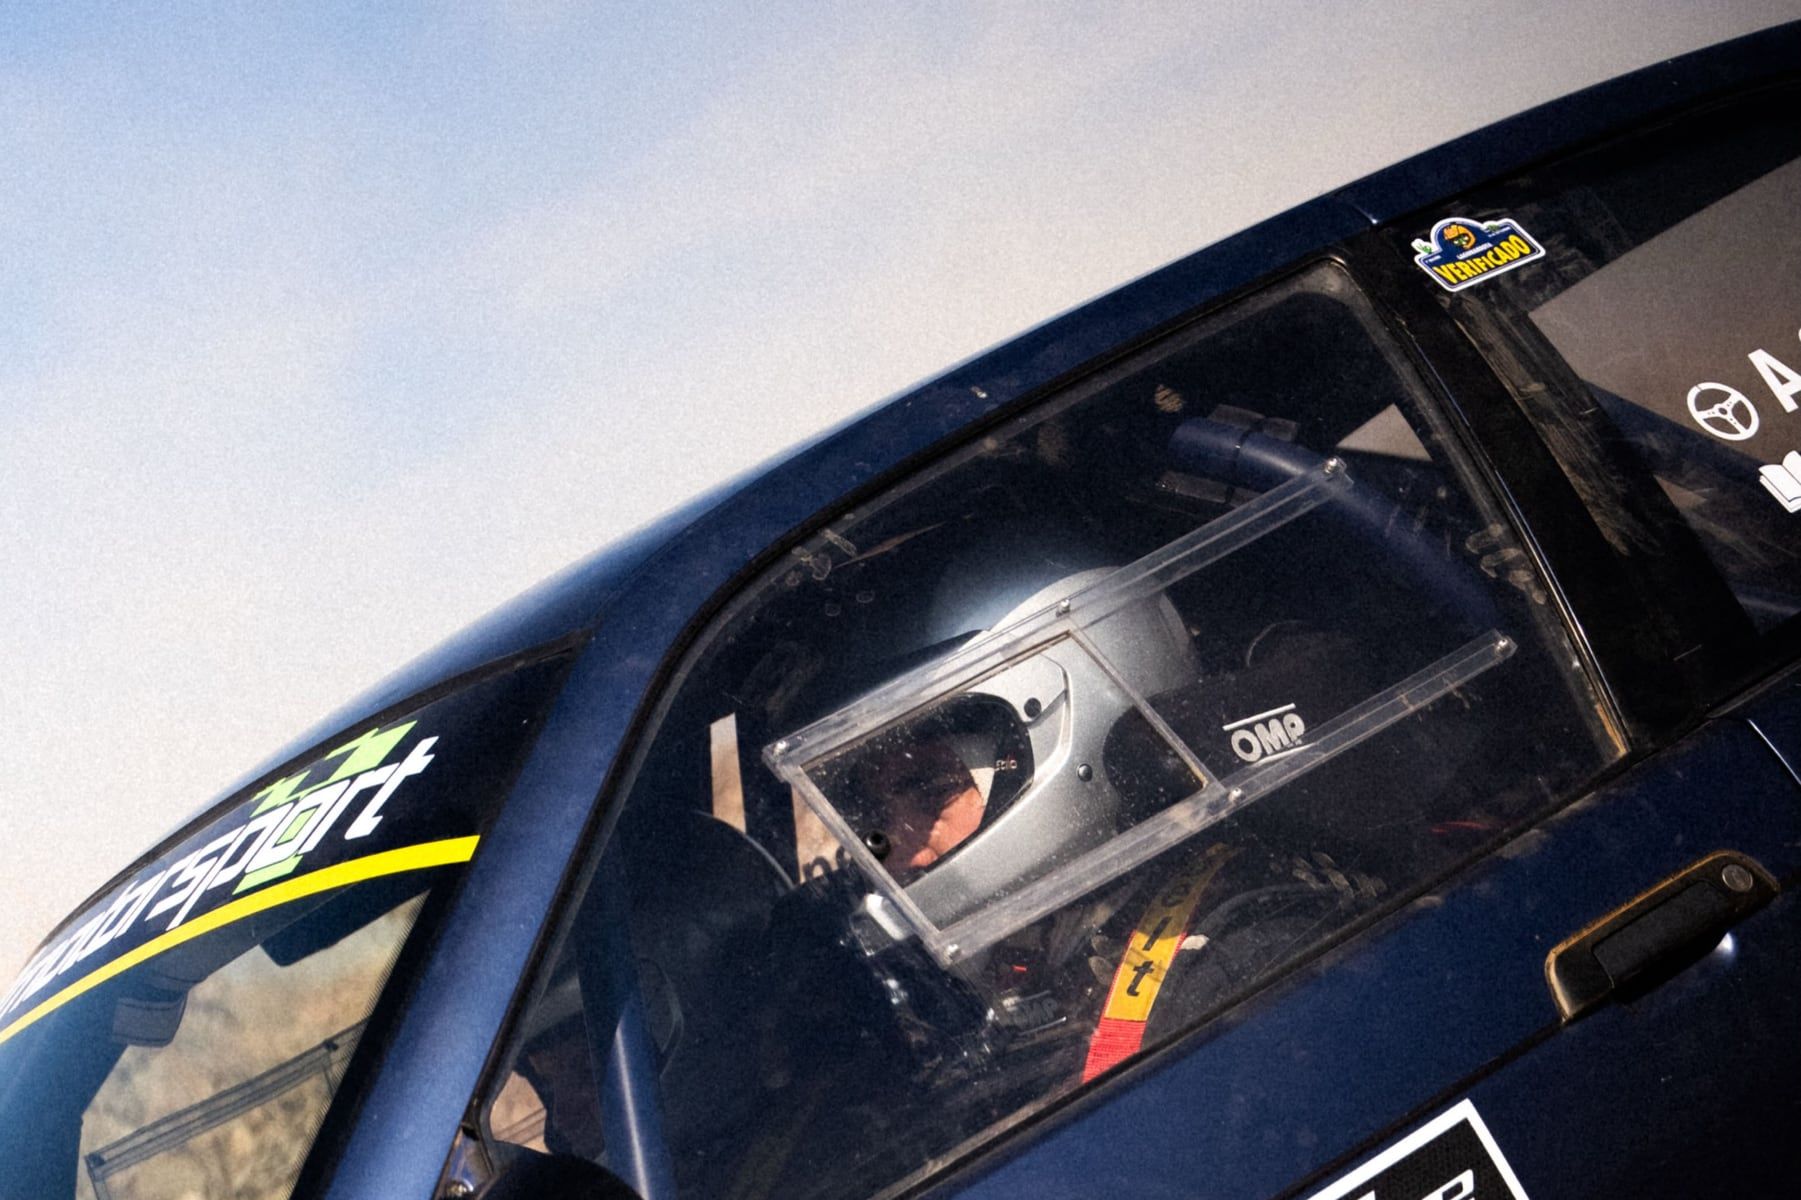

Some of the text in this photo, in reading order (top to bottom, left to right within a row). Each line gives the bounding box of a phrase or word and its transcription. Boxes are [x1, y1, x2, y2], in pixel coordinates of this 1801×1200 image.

[1432, 234, 1532, 284] VERIFICADO
[1747, 331, 1801, 414] A
[1230, 712, 1306, 763] OMP
